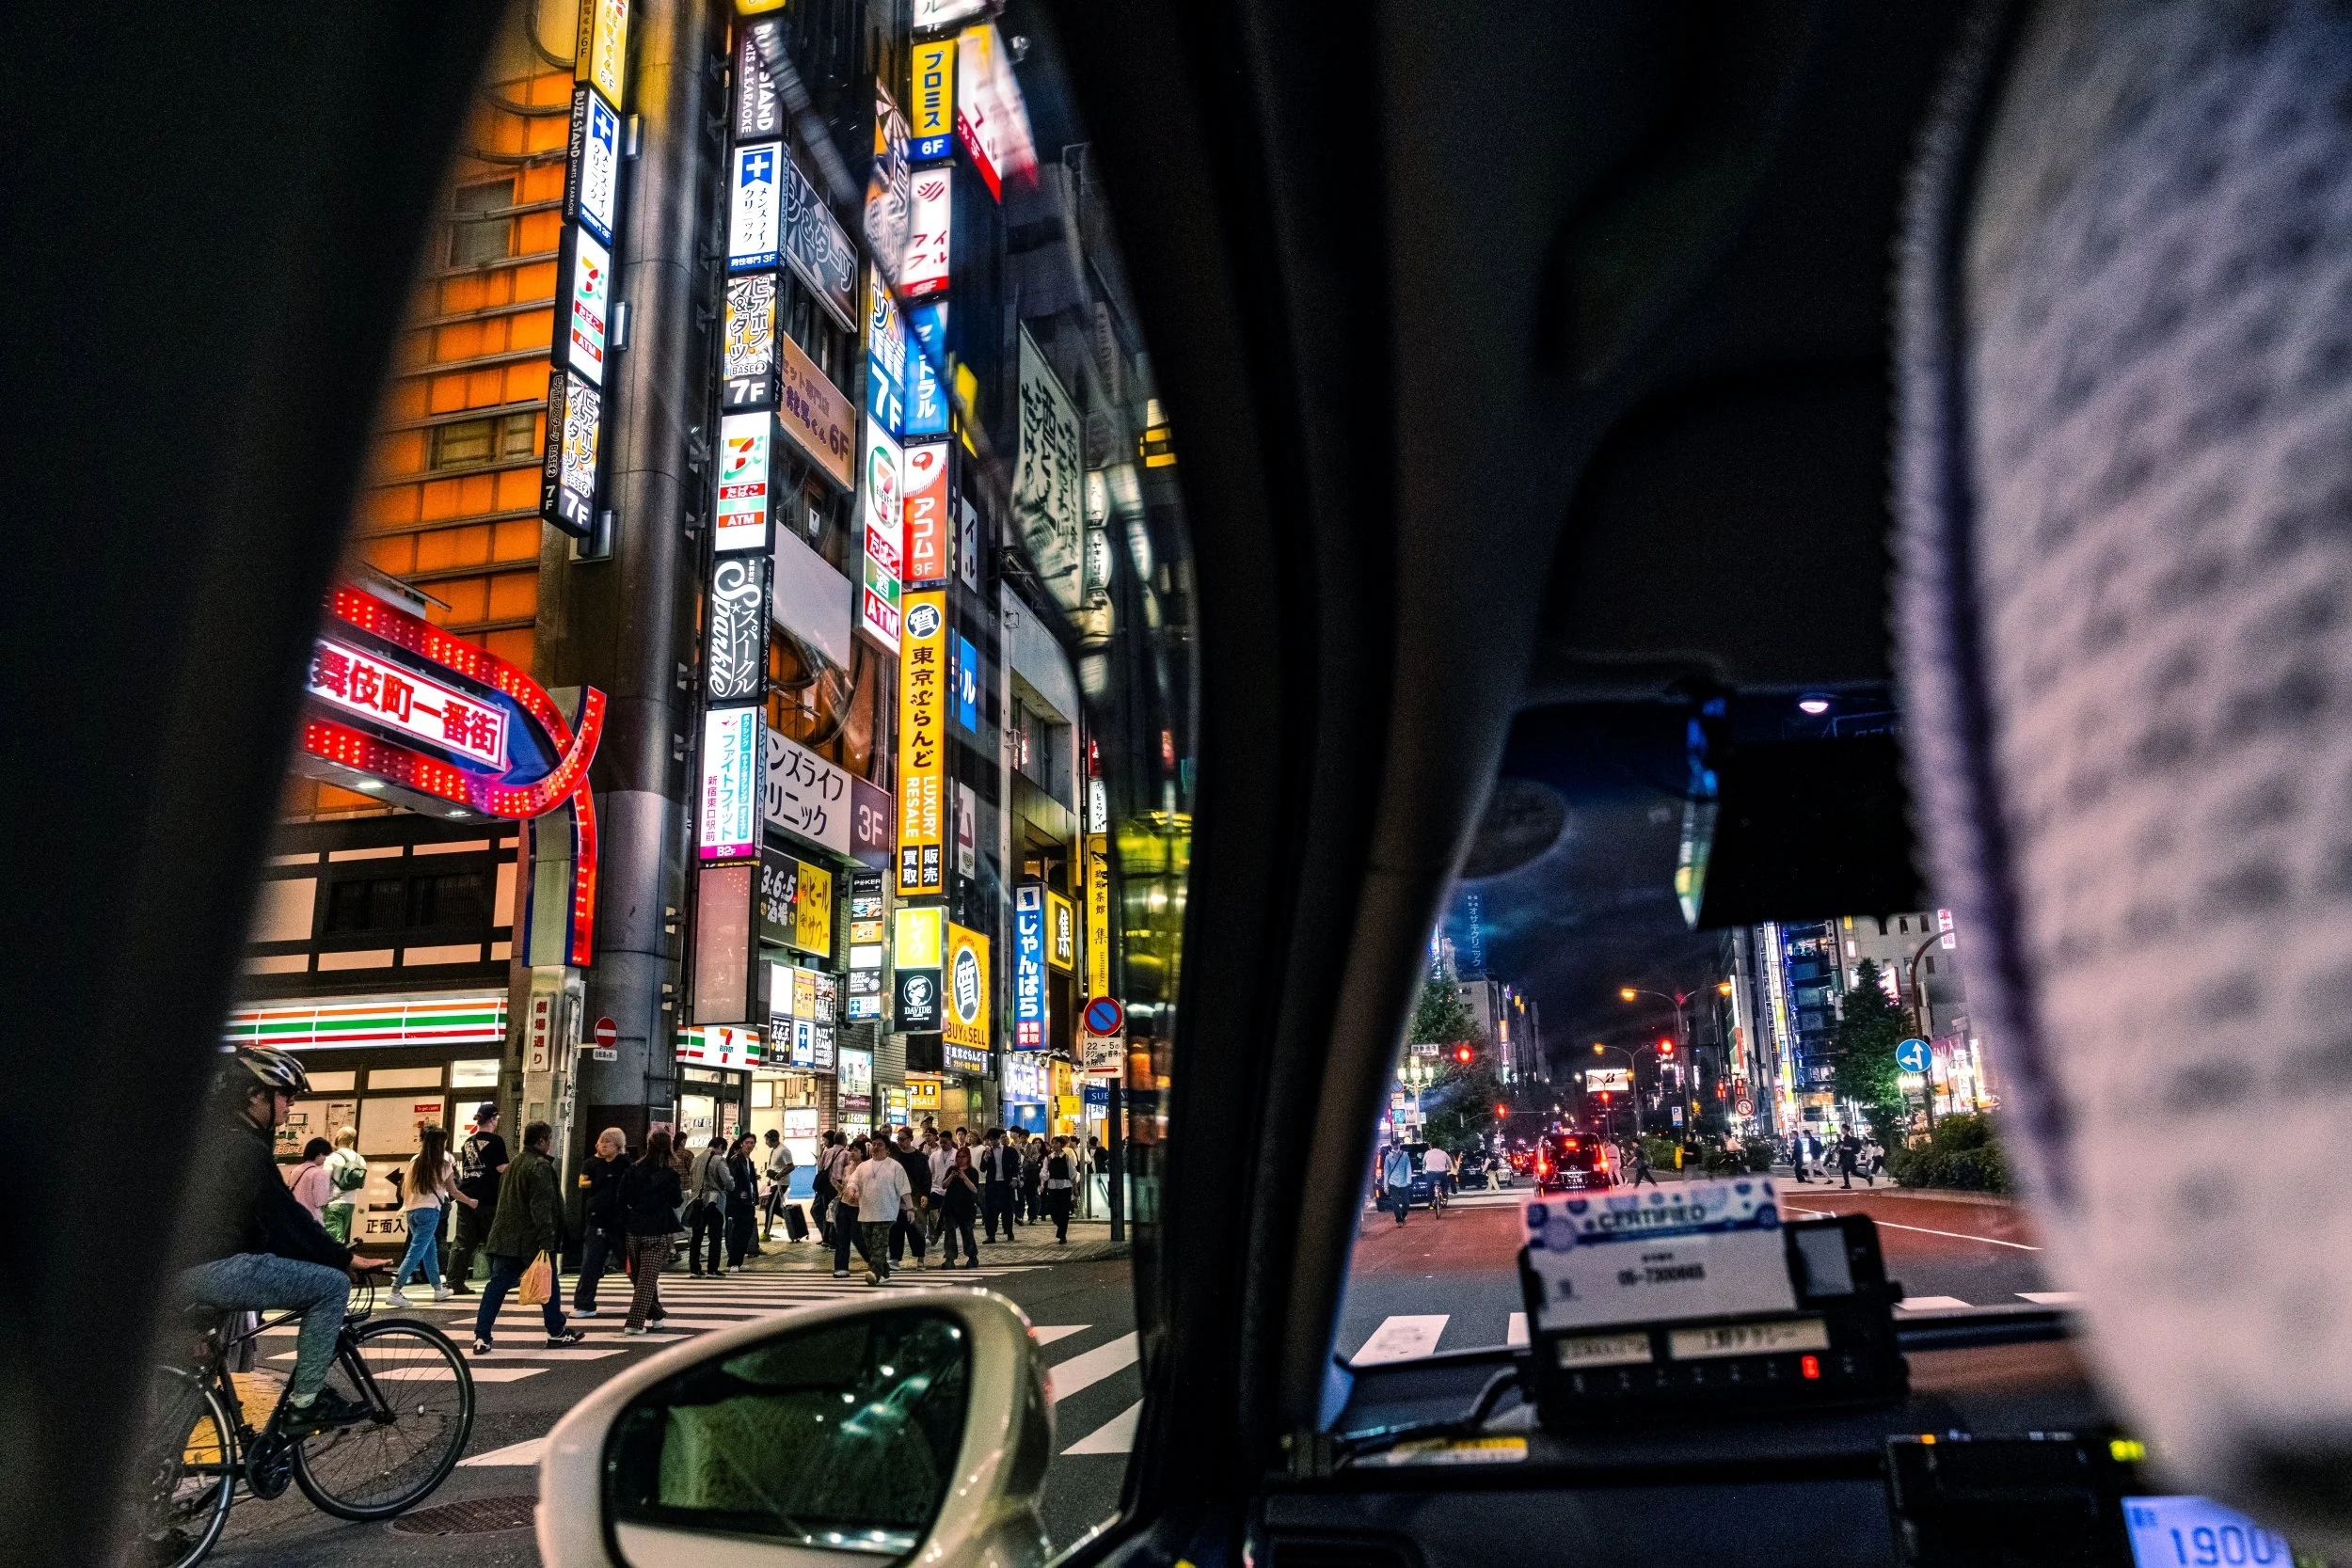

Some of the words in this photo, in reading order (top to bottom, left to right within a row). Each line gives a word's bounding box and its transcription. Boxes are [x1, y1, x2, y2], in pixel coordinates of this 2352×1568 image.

[744, 66, 755, 74] &
[745, 40, 755, 63] ARTS
[573, 90, 586, 119] BUZZ
[741, 78, 755, 134] KARAOKE
[924, 50, 945, 129] プロミス
[571, 119, 582, 158] STAND
[922, 139, 945, 155] 6F
[743, 189, 755, 243] クリニック
[756, 188, 768, 251] メンズライフ
[731, 256, 761, 267] 男性専門
[762, 254, 775, 263] 3F
[578, 336, 596, 357] ATM
[729, 379, 766, 404] 7F
[872, 361, 902, 433] 7F
[830, 423, 850, 462] 6F
[546, 485, 555, 511] 7F
[564, 489, 590, 525] 7F
[726, 485, 759, 498] たばこ
[726, 514, 755, 527] ATM
[914, 497, 935, 559] アコム
[870, 532, 900, 575] たばこ
[914, 562, 934, 576] 3F
[876, 567, 890, 595] 酒
[869, 594, 899, 641] ATM
[910, 607, 937, 637] 質
[731, 610, 758, 697] スパークル
[770, 736, 844, 801] ンズライフ
[721, 734, 736, 842] ファイトフィット
[923, 775, 937, 838] LUXURY
[706, 775, 718, 842] 新宿東口駅前
[769, 782, 827, 836] リニック
[858, 804, 883, 846] 3F
[905, 777, 920, 839] RESALE
[717, 846, 737, 857] B2F
[903, 849, 917, 884] 買取
[924, 848, 939, 883] 販売
[767, 897, 788, 927] 酒場
[809, 875, 830, 913] ビール
[1057, 908, 1071, 958] 集
[1094, 927, 1107, 945] 集
[1469, 908, 1481, 967] オザキクリニック
[904, 1006, 932, 1015] DAVIDE
[533, 1001, 548, 1065] 劇場通り
[947, 1022, 963, 1040] BUY
[969, 1027, 985, 1045] SELL
